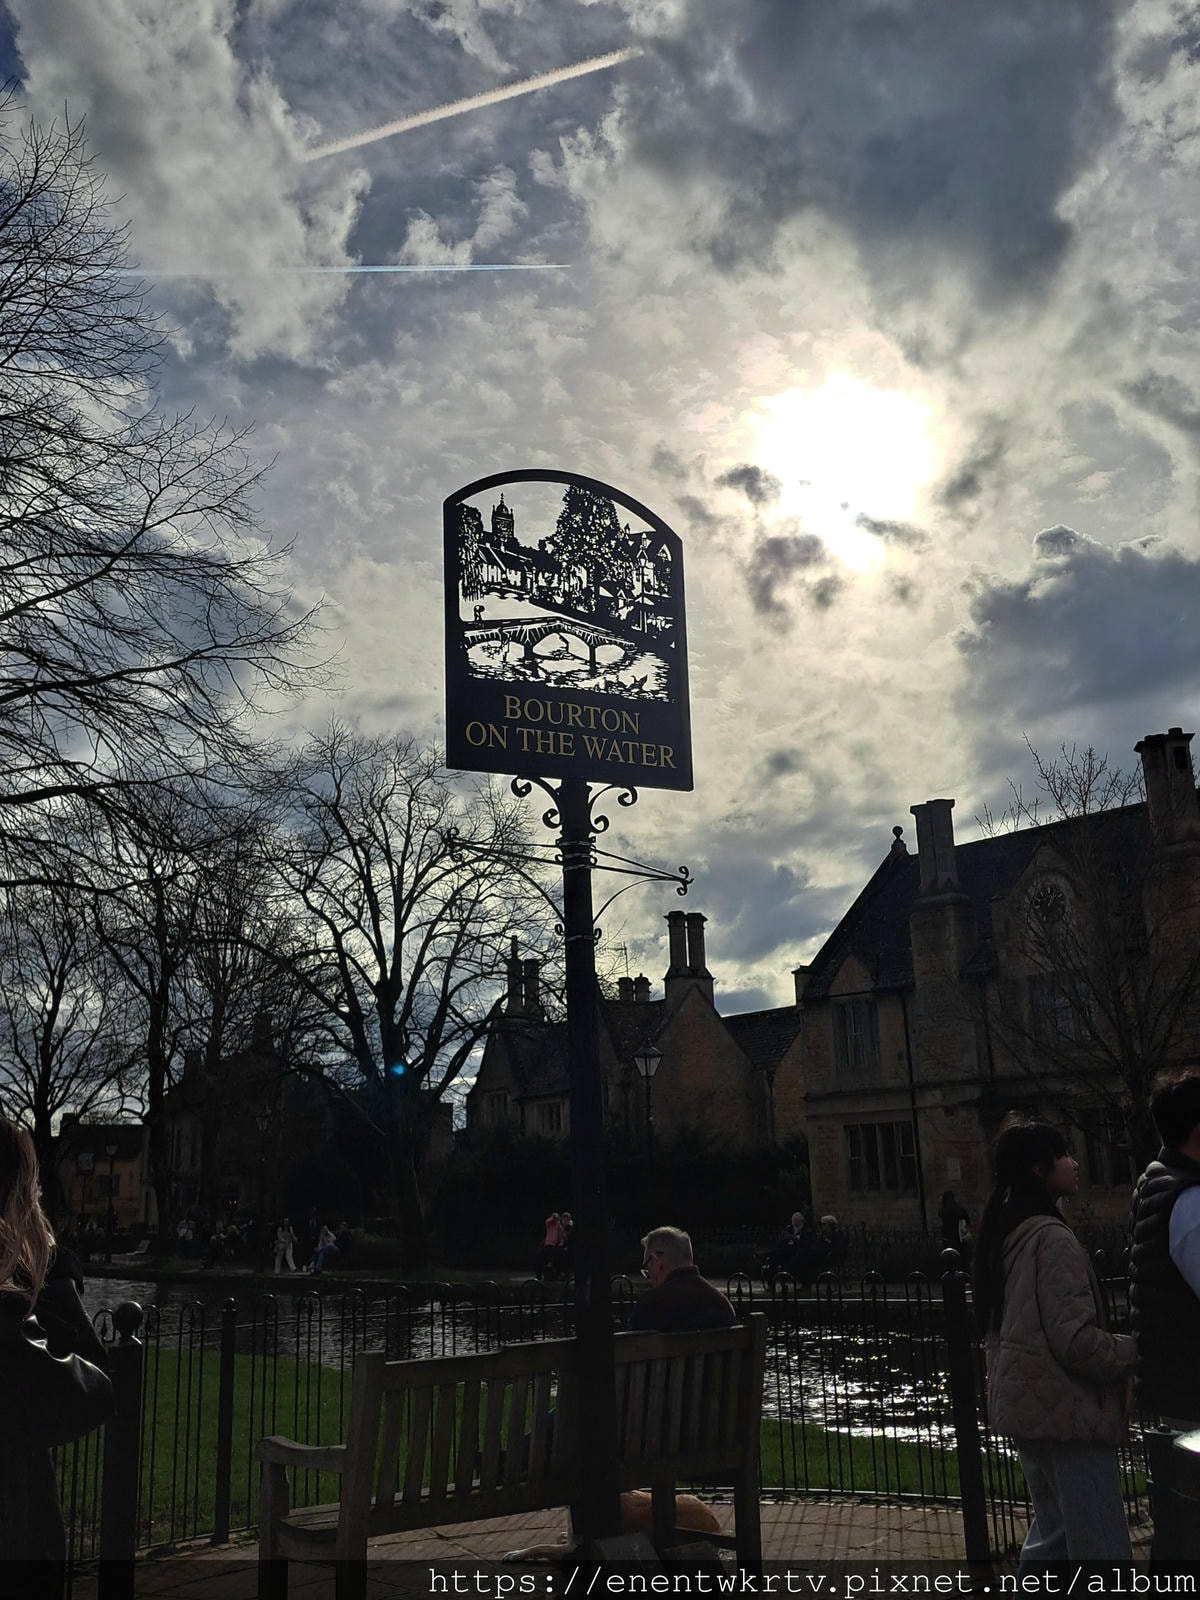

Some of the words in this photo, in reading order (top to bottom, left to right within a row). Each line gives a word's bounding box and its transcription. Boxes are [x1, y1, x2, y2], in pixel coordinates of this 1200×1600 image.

[504, 695, 640, 734] BOURTON
[465, 721, 508, 749] ON
[517, 727, 576, 756] THE
[583, 735, 677, 769] WATER
